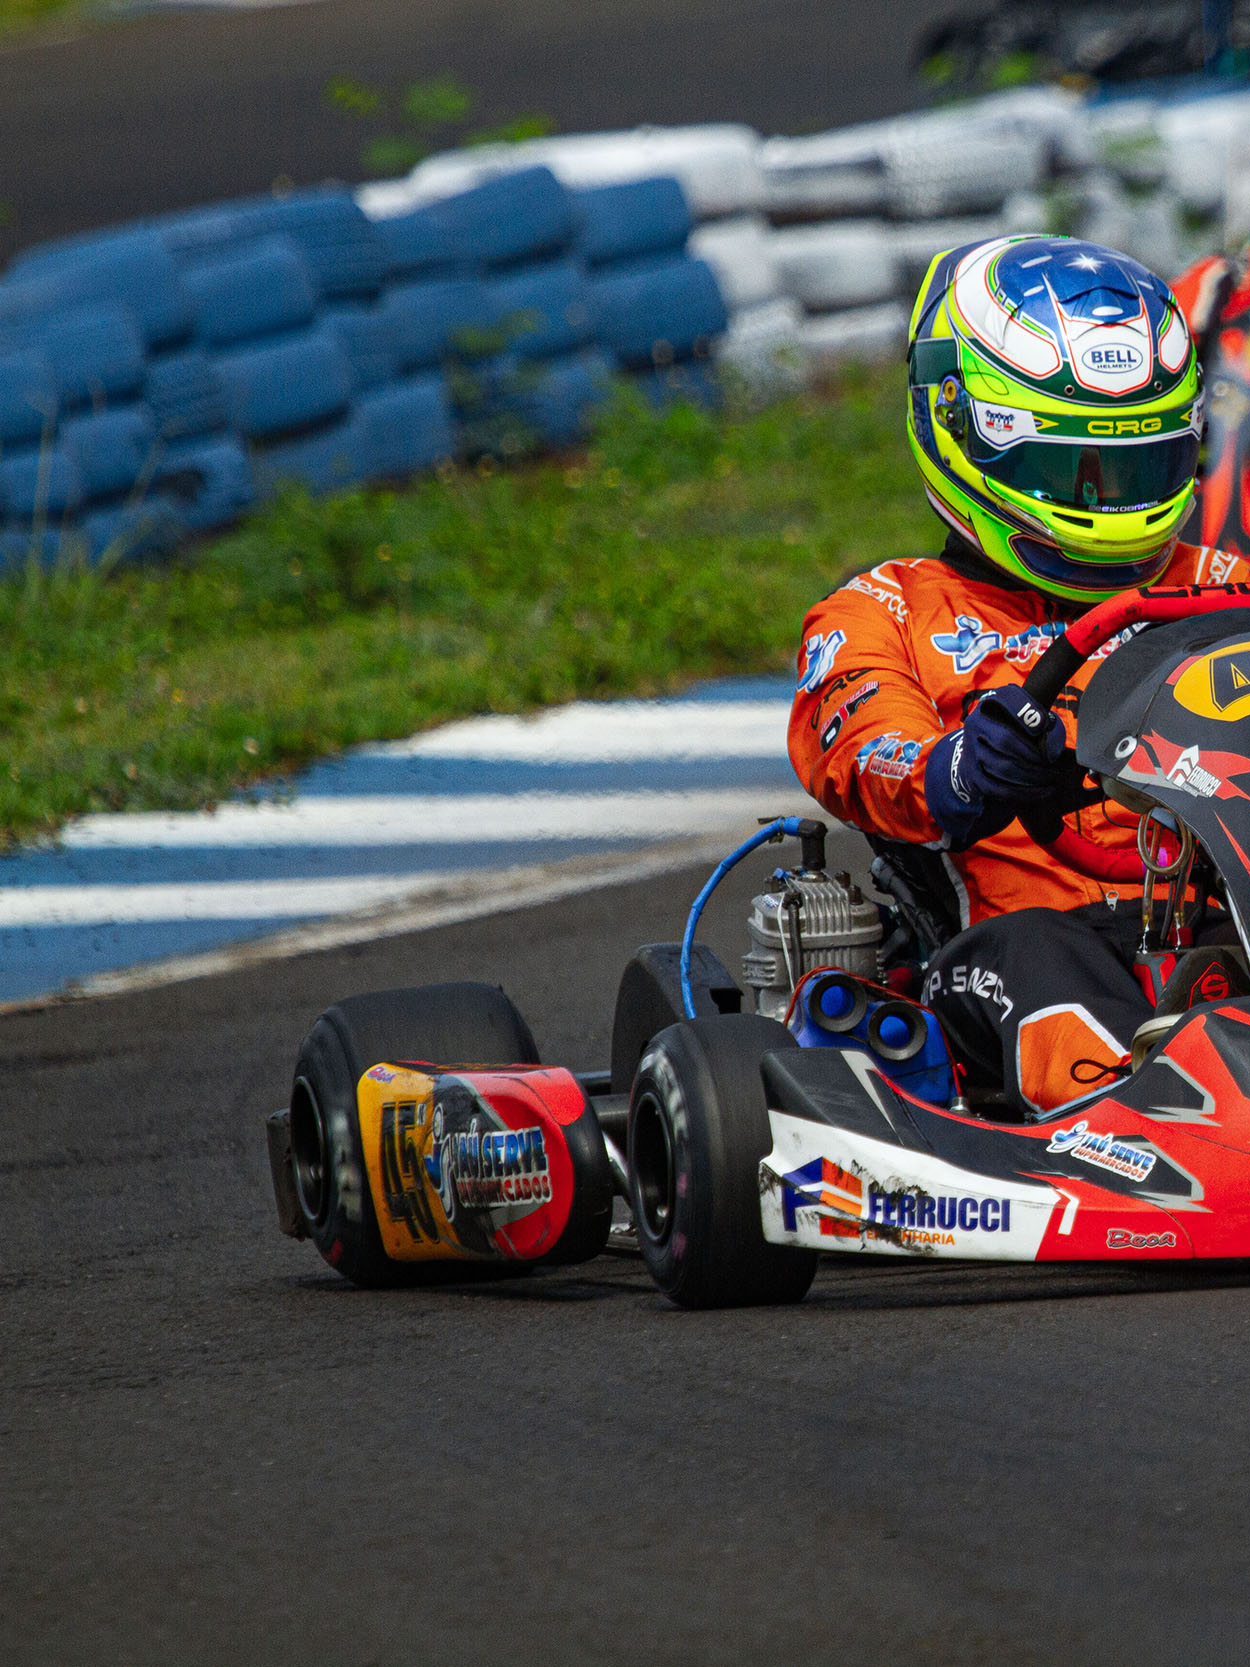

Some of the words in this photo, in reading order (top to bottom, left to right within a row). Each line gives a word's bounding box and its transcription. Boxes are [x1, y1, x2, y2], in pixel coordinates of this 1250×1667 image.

[1091, 350, 1137, 364] BELL
[1087, 417, 1162, 435] CRG
[1186, 765, 1222, 798] FERRUCCI
[482, 1127, 548, 1178] SERVE
[1074, 1147, 1146, 1180] SUPERMERCADOS
[1081, 1133, 1112, 1153] JAÚ
[1107, 1143, 1154, 1170] SERVE
[867, 1191, 1010, 1232] FERRUCCI
